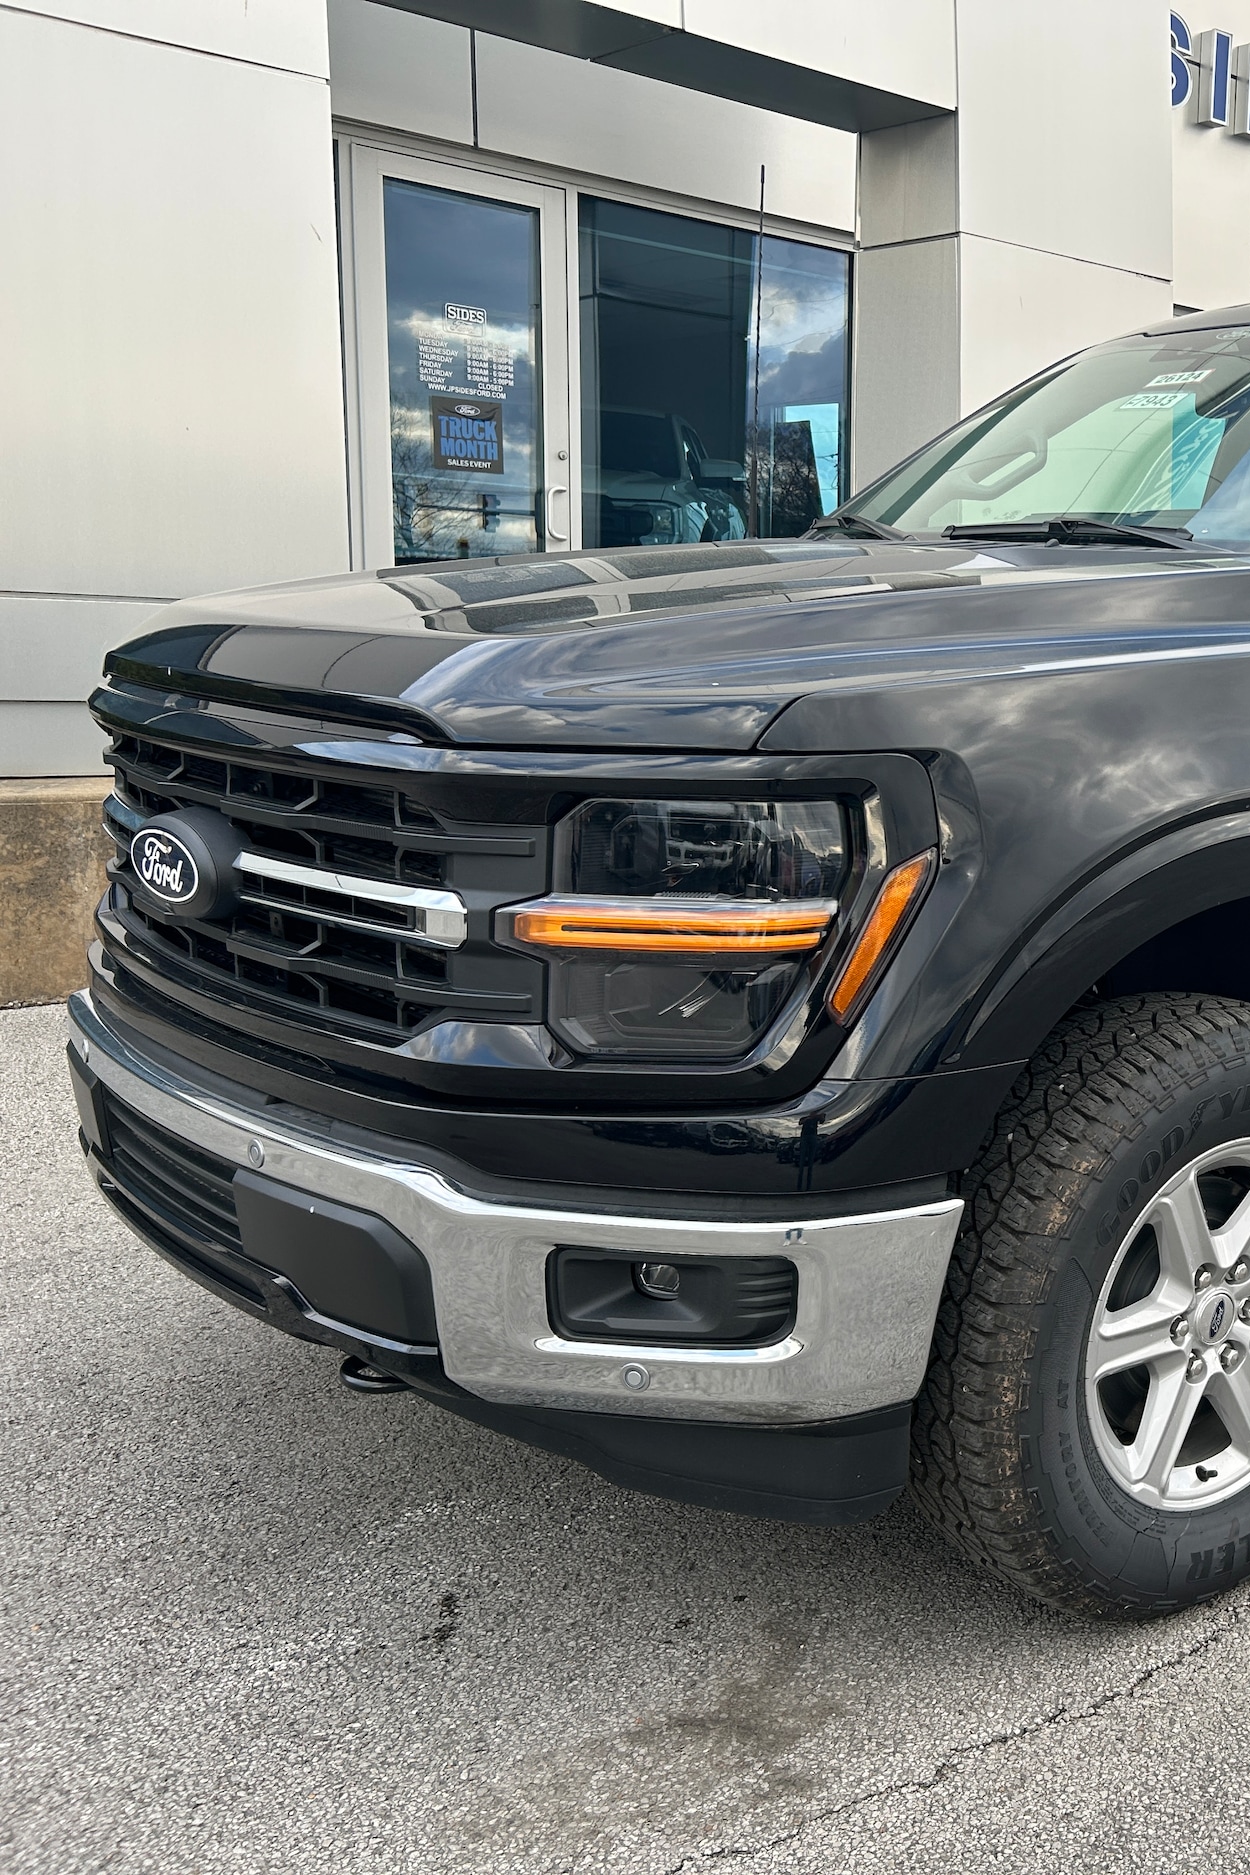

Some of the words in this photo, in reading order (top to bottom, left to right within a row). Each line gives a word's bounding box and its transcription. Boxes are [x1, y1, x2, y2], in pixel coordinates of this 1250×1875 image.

[447, 305, 485, 324] SIDES
[419, 338, 448, 348] TUESDAY
[419, 345, 459, 357] WEDNESDAY
[419, 352, 453, 363] THURSDAY
[467, 359, 489, 369] 9:00AM
[493, 363, 514, 373] 6:00PM
[419, 360, 442, 369] FRIDAY
[467, 366, 489, 376] 9:00AM
[493, 370, 514, 380] 6:00PM
[419, 367, 453, 378] SATURDAY
[467, 374, 489, 383] 9:00AM
[419, 374, 446, 384] SUNDAY
[478, 382, 504, 393] CLOSED
[1155, 371, 1204, 384] 26124
[428, 382, 507, 400] WWW.JPSIDESFORD.COM
[438, 415, 497, 441] TRUCK
[440, 437, 498, 461] MONTH
[447, 459, 469, 468] SALES
[469, 460, 492, 469] EVENT
[141, 836, 184, 893] Ford
[1058, 1431, 1116, 1548] TERRITORY
